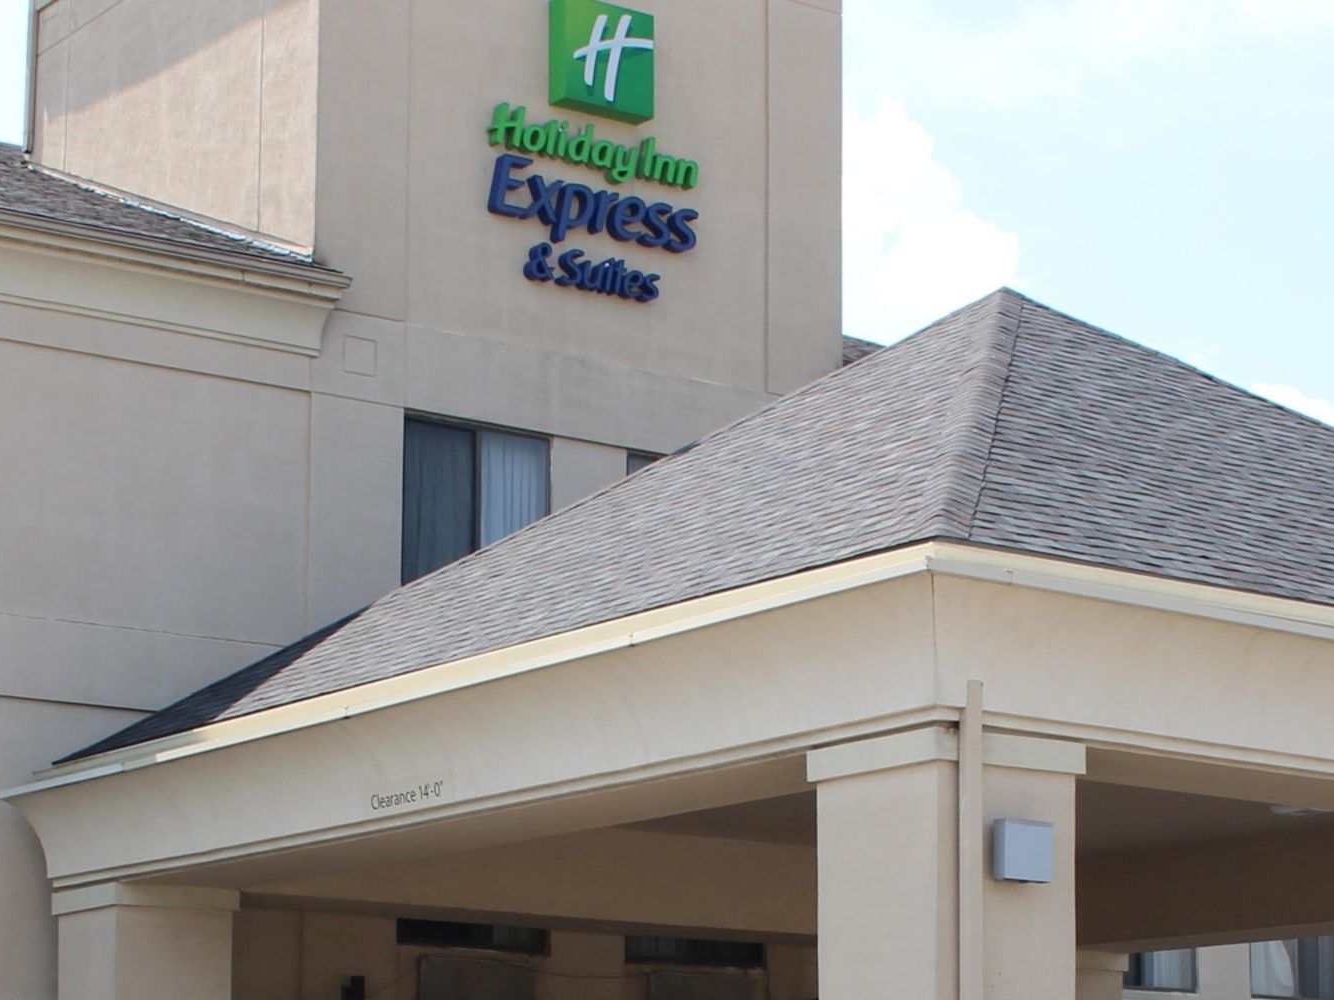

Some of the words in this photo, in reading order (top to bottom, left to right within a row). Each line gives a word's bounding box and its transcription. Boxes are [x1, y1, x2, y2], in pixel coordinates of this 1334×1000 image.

[487, 102, 639, 185] Holiday
[638, 137, 699, 189] Inn
[487, 153, 699, 253] Express
[523, 242, 555, 281] &
[554, 249, 661, 302] Suites
[370, 791, 416, 810] Clearance
